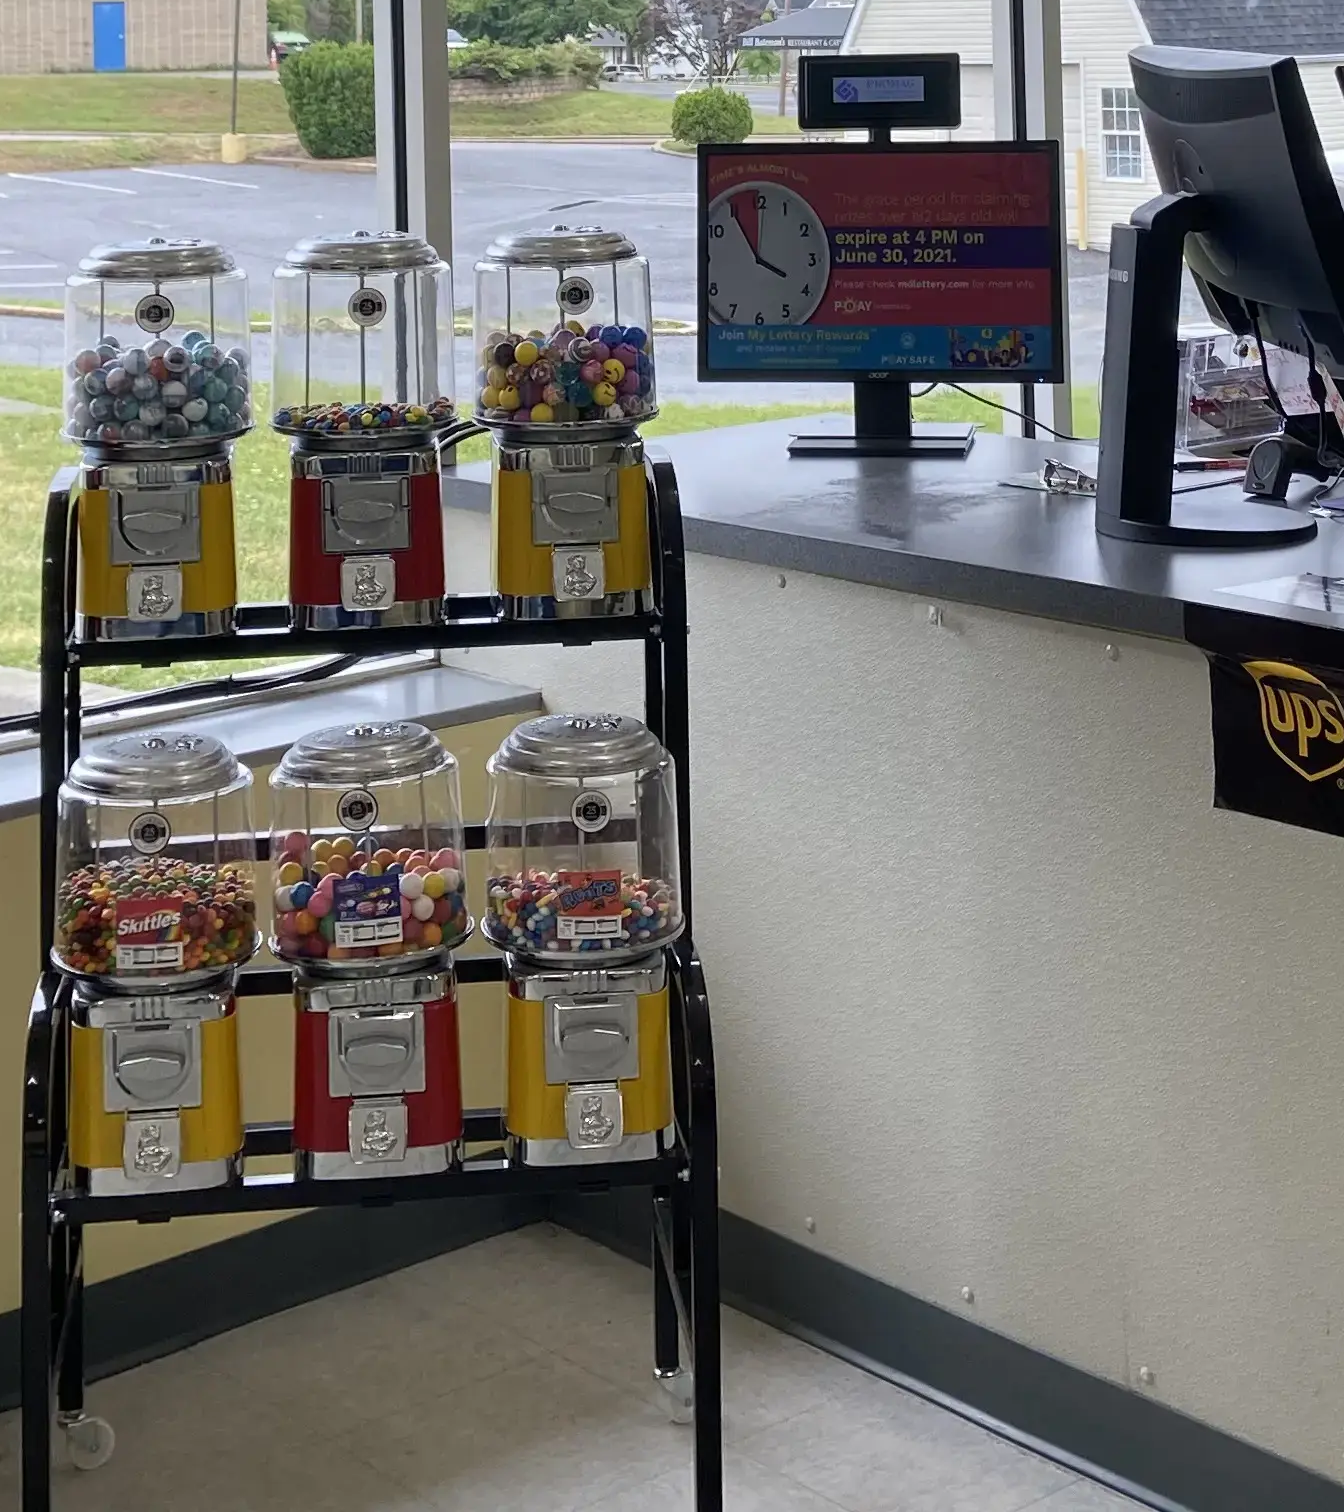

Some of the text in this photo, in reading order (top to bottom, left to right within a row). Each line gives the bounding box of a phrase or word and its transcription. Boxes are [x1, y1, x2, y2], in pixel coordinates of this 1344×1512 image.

[835, 230, 984, 246] expire at 4 PM on
[835, 249, 957, 266] June 30, 2021.
[718, 329, 745, 341] Join
[116, 910, 182, 939] Skittles
